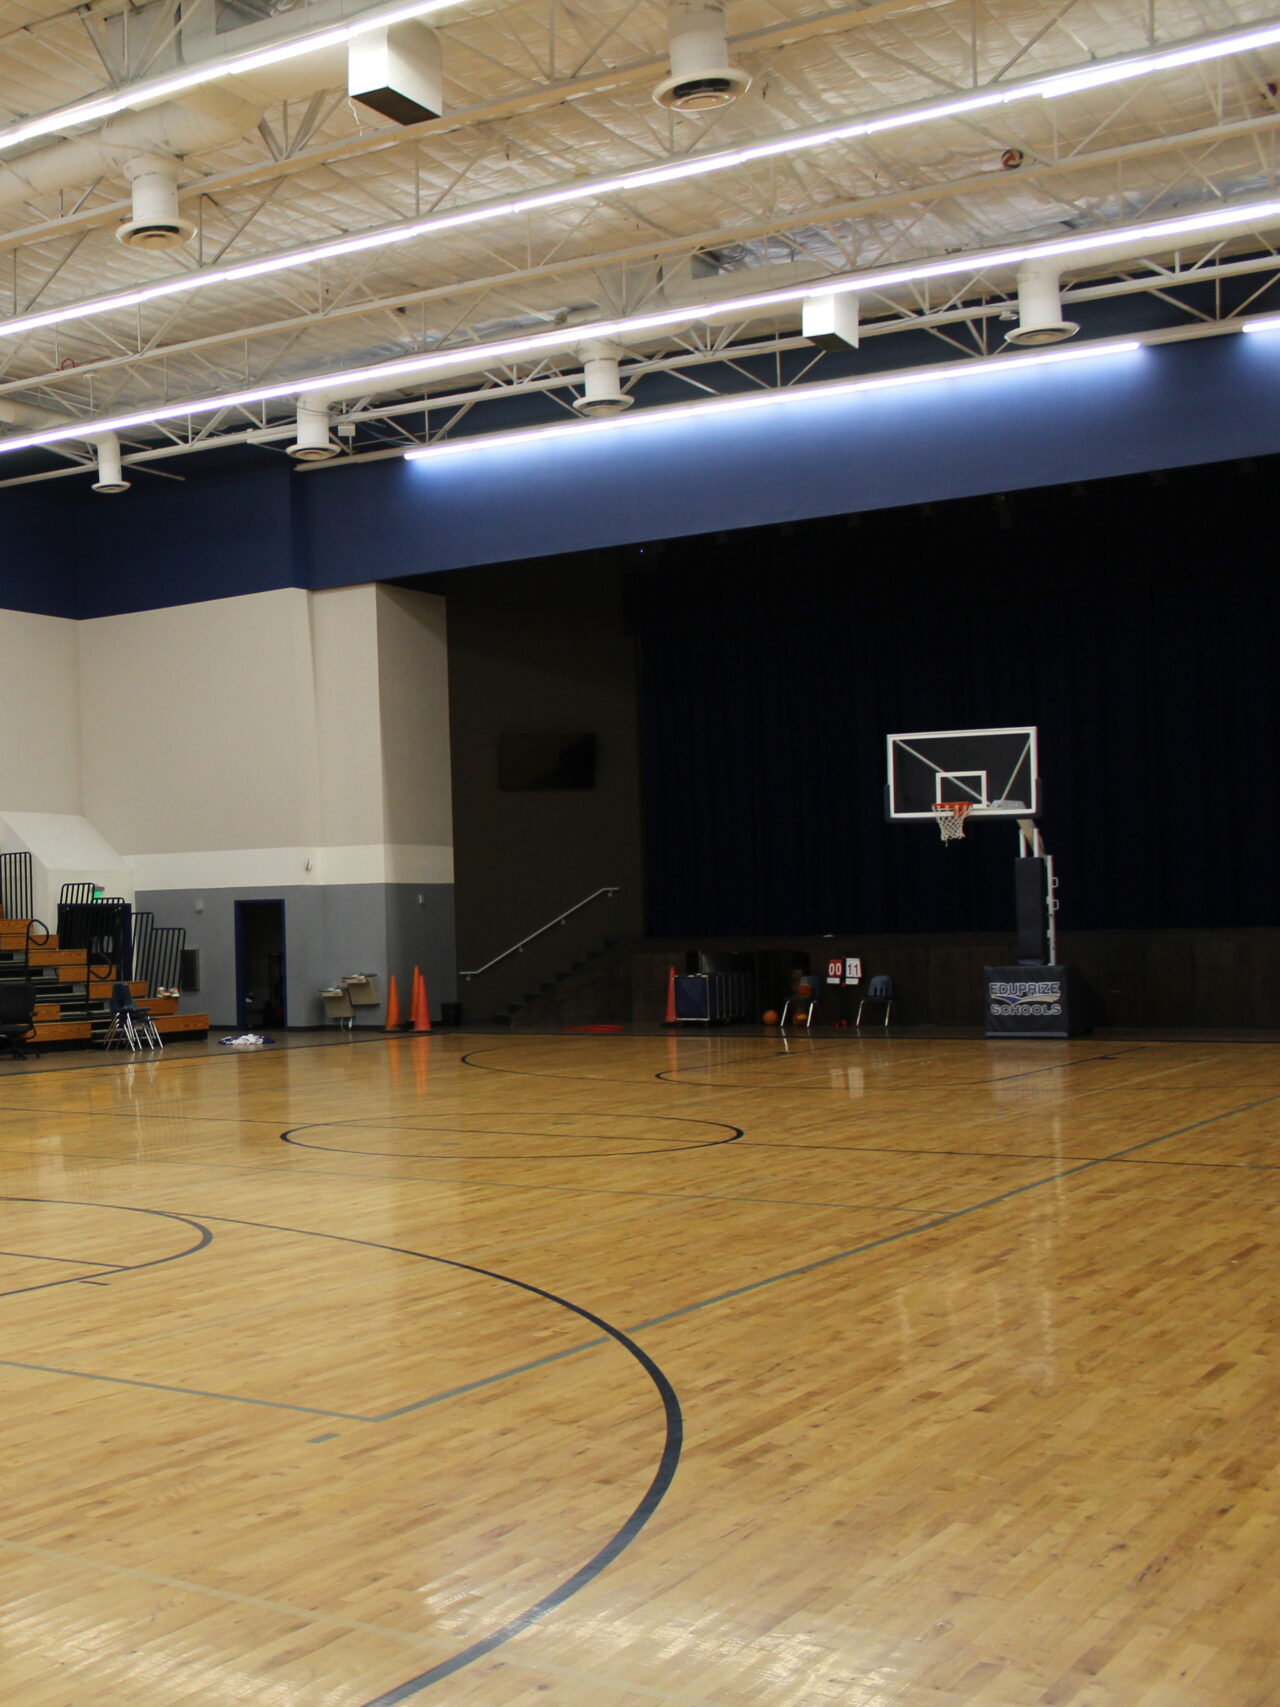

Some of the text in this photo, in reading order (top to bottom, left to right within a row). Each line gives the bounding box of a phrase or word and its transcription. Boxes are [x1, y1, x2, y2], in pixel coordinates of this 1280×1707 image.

[829, 963, 841, 976] 00
[989, 982, 1060, 995] EDUPRIZE
[990, 1004, 1062, 1015] SCHOOLS
